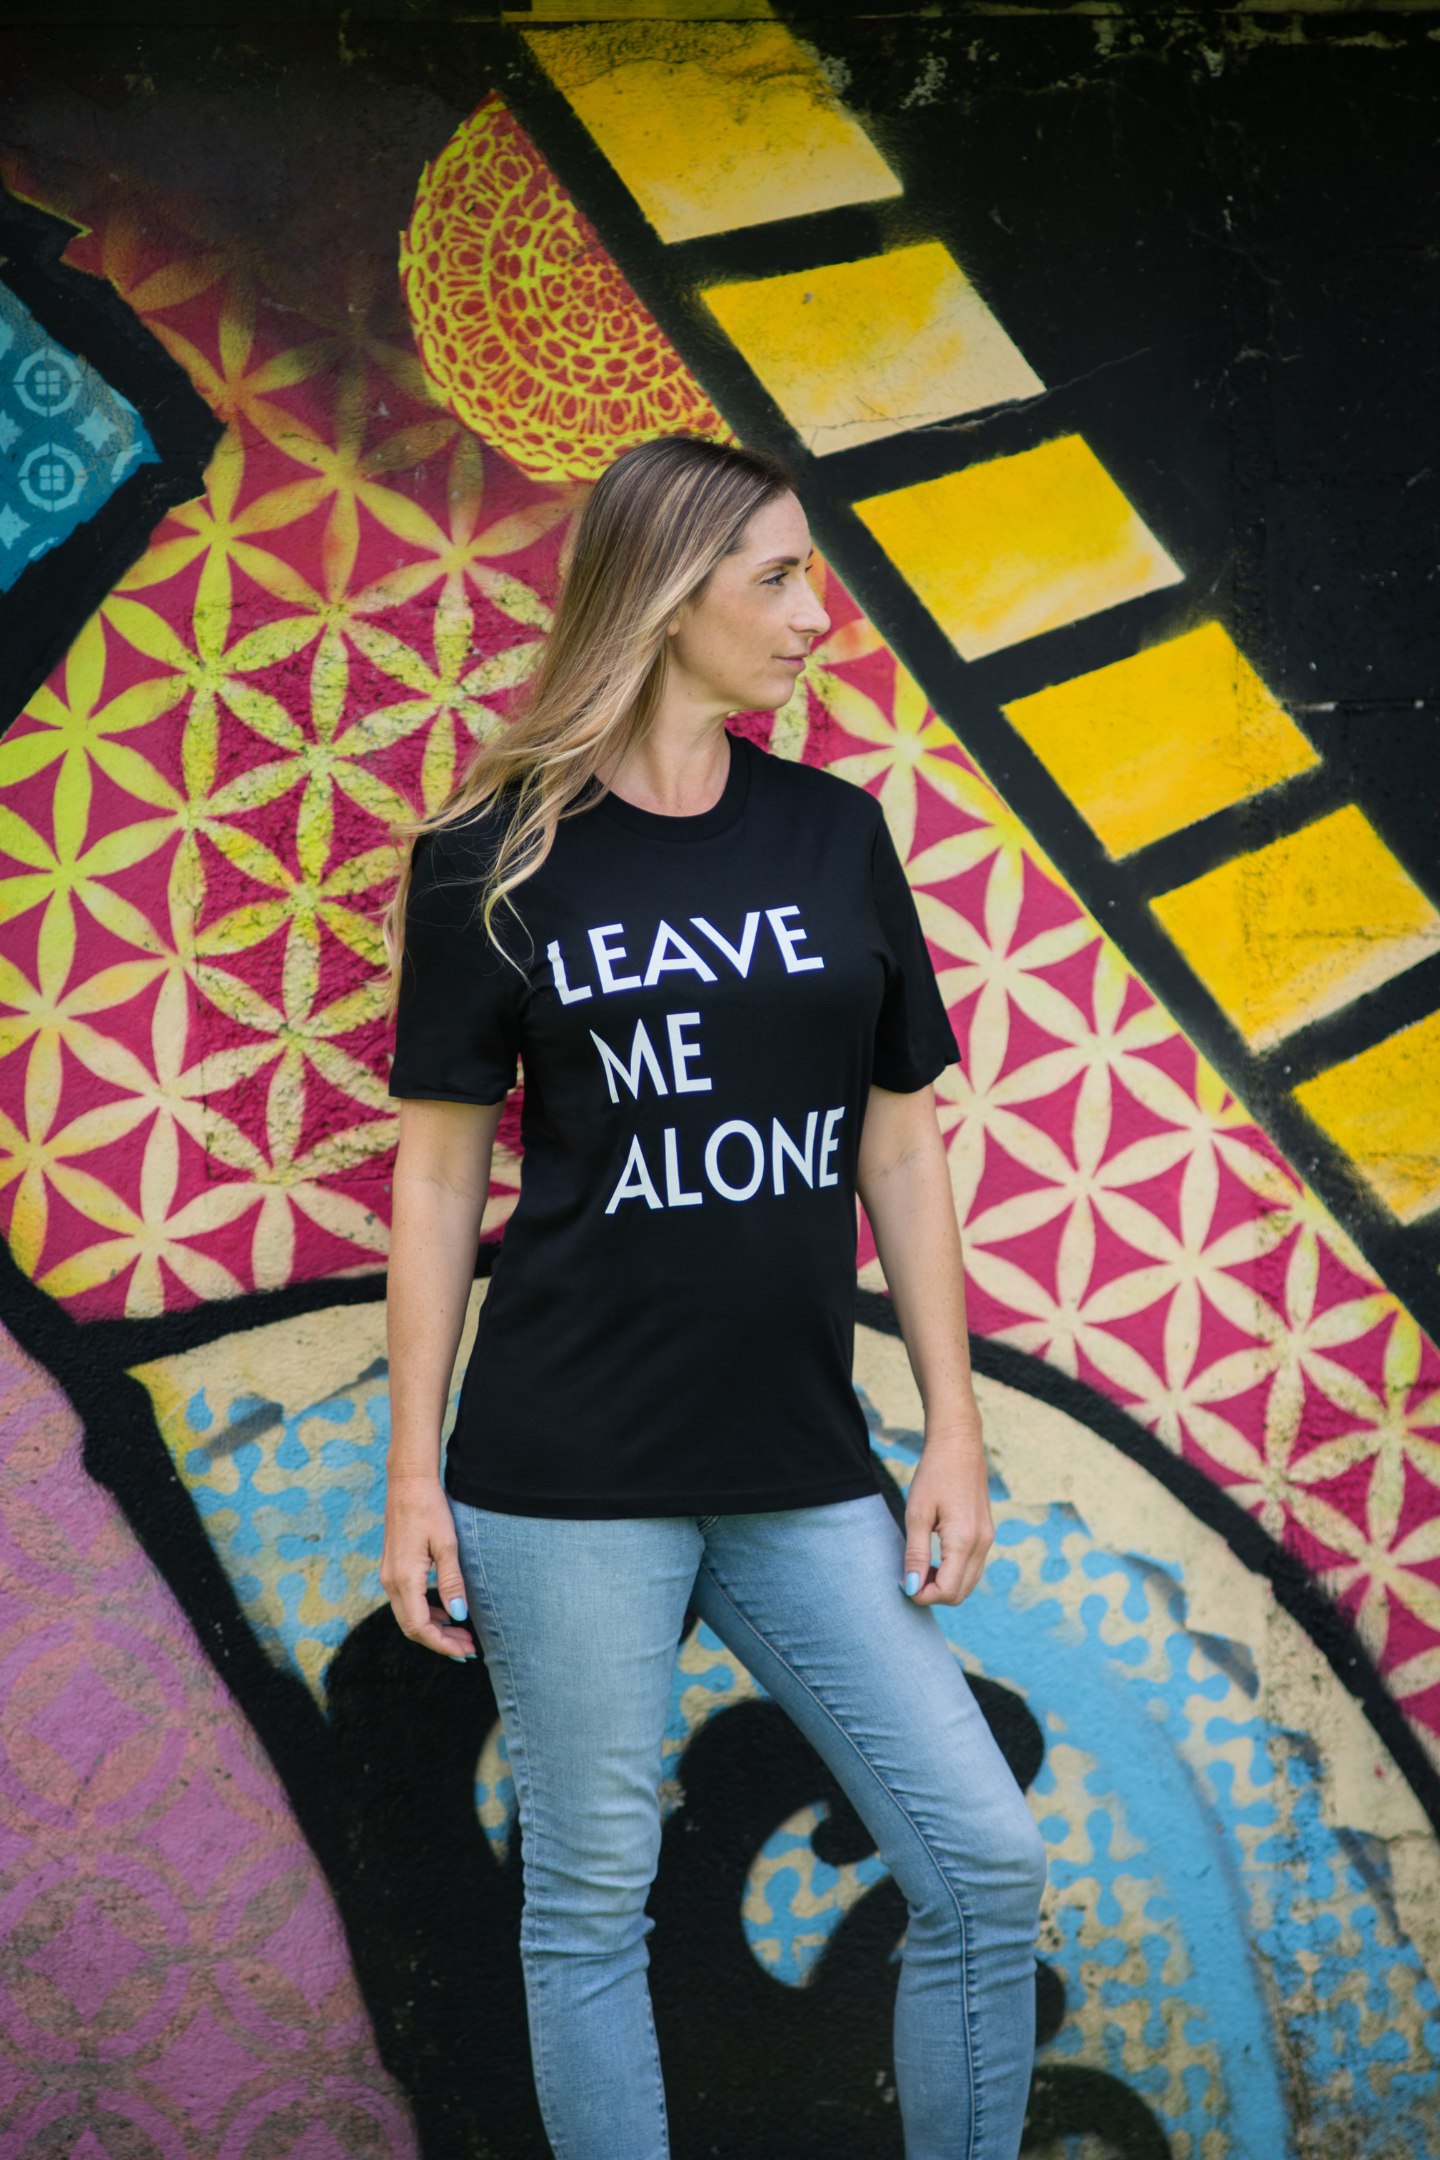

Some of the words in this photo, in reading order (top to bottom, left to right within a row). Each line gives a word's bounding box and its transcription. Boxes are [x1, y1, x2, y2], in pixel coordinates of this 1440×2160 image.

[547, 905, 825, 1005] LEAVE
[589, 1011, 713, 1104] ME
[604, 1106, 846, 1215] ALONE
